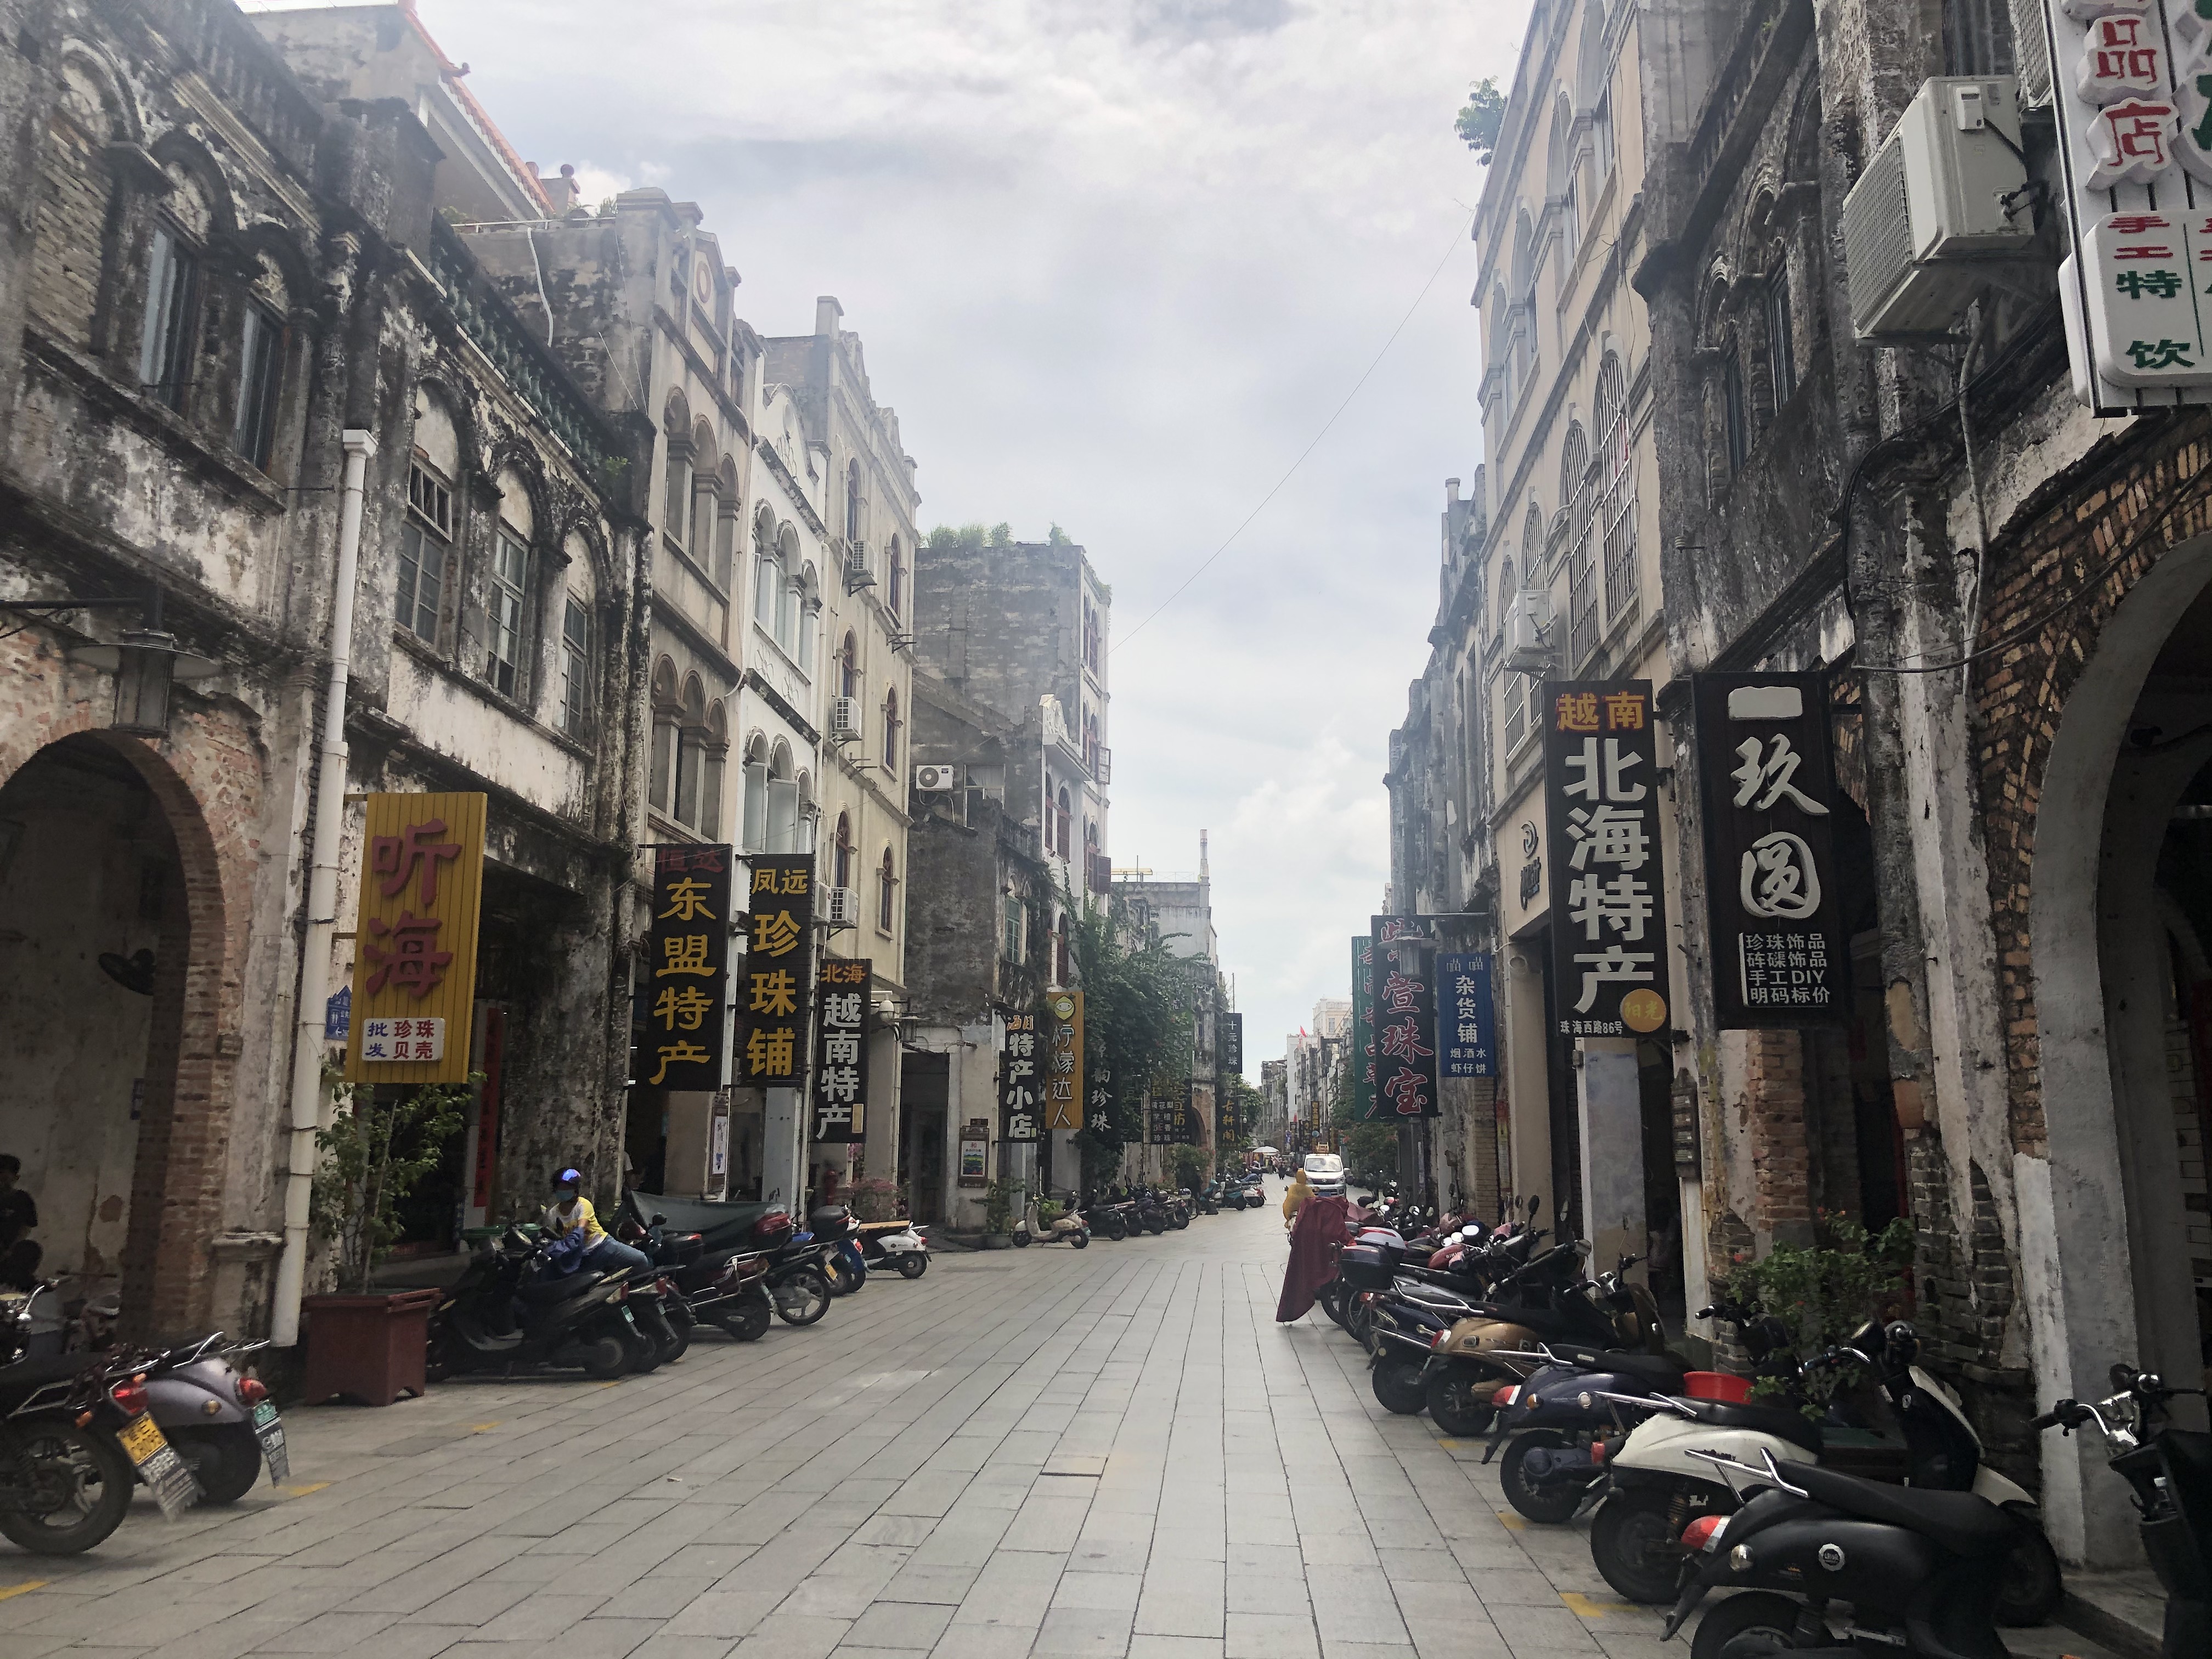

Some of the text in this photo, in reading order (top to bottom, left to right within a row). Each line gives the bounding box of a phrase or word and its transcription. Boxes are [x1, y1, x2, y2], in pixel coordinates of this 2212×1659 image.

[1556, 691, 1645, 732] 越南
[1728, 686, 1830, 919] 一玖圆
[751, 868, 808, 895] 凤远
[1562, 737, 1654, 1013] 北海特产
[363, 819, 462, 998] 听海
[1745, 933, 1825, 950] 珍珠饰品
[650, 877, 716, 1085] 东盟特产
[746, 910, 802, 1076] 珍珠铺
[821, 963, 867, 984] 北海
[1749, 969, 1825, 986] 手工DIY
[1455, 975, 1477, 1043] 杂货铺
[1751, 986, 1830, 1004] 明码标价
[394, 1020, 435, 1038] 珍珠
[1228, 1020, 1237, 1065] 十元珍珠
[1560, 1020, 1623, 1034] 珠海西路86号
[393, 1041, 433, 1059] 贝壳
[816, 994, 862, 1139] 越南特产
[1450, 1047, 1486, 1059] 烟酒水
[1451, 1062, 1486, 1074] 虾仔饼
[1007, 1032, 1034, 1139] 特产小店
[1052, 1024, 1074, 1127] 柠檬达人
